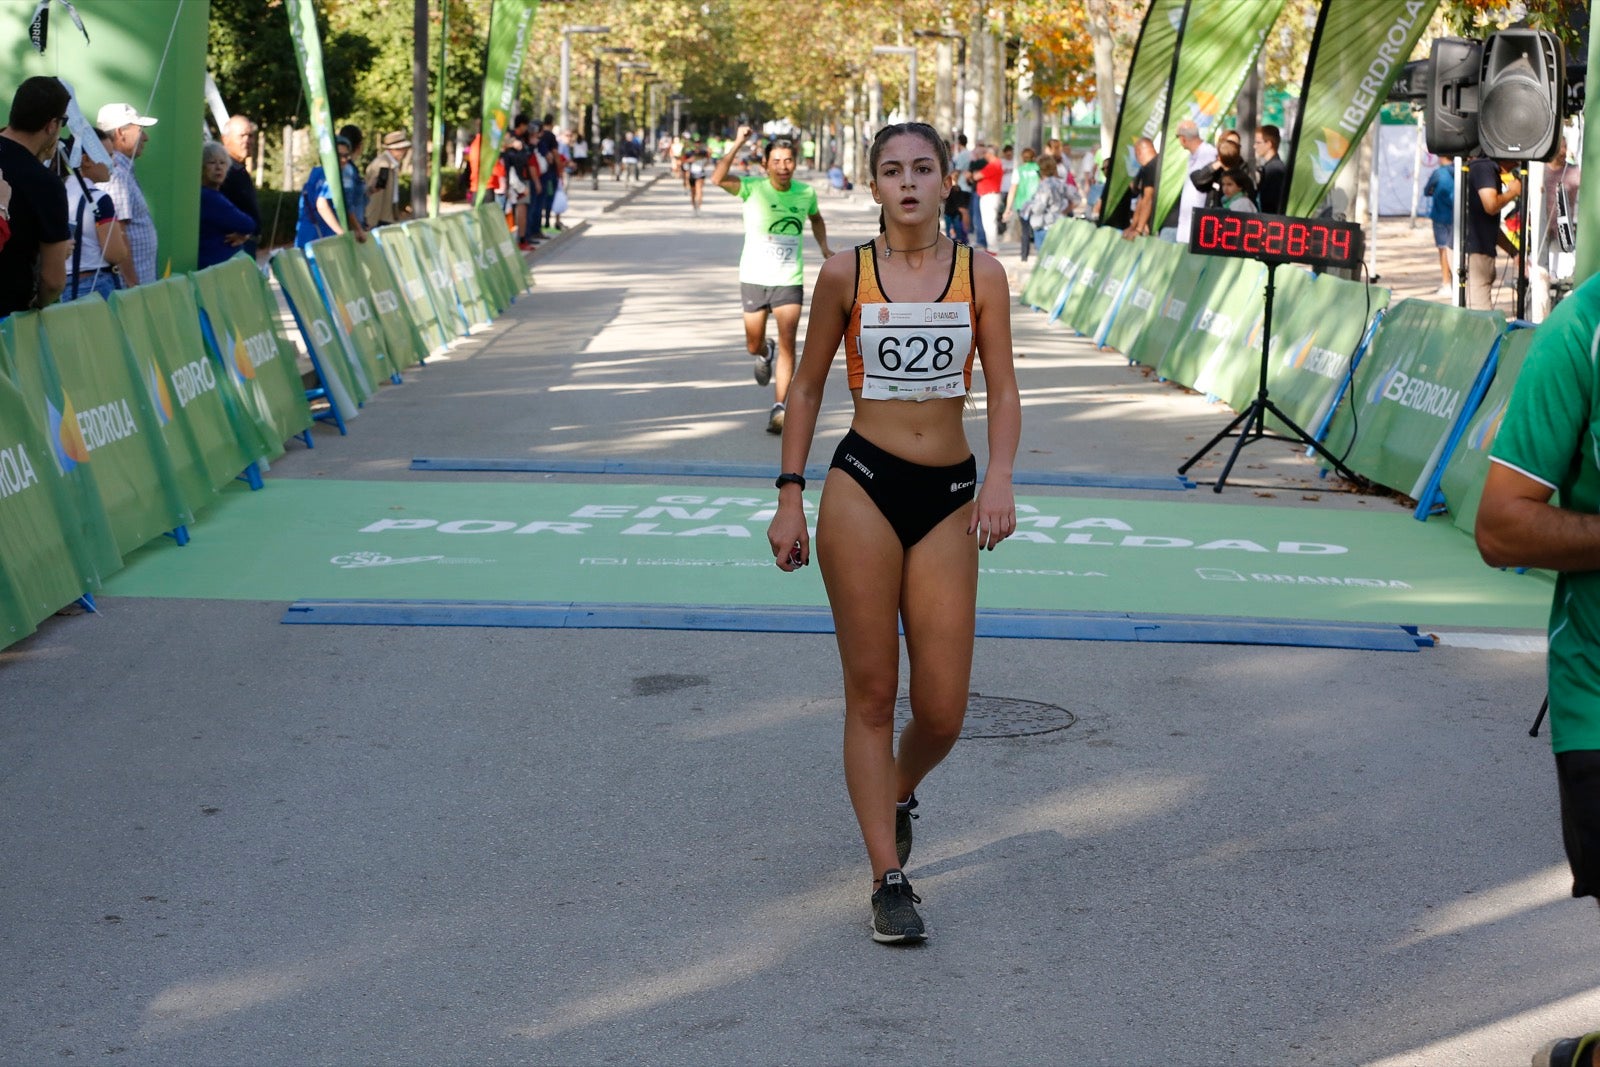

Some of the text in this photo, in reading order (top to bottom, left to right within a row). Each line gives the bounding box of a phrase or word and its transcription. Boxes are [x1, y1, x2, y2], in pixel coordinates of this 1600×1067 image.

[1338, 0, 1426, 134] IBERDROLA
[1198, 215, 1351, 260] 0:22:28:74
[878, 336, 955, 373] 628
[358, 518, 593, 534] POR
[620, 523, 752, 537] LA
[569, 504, 723, 520] EN
